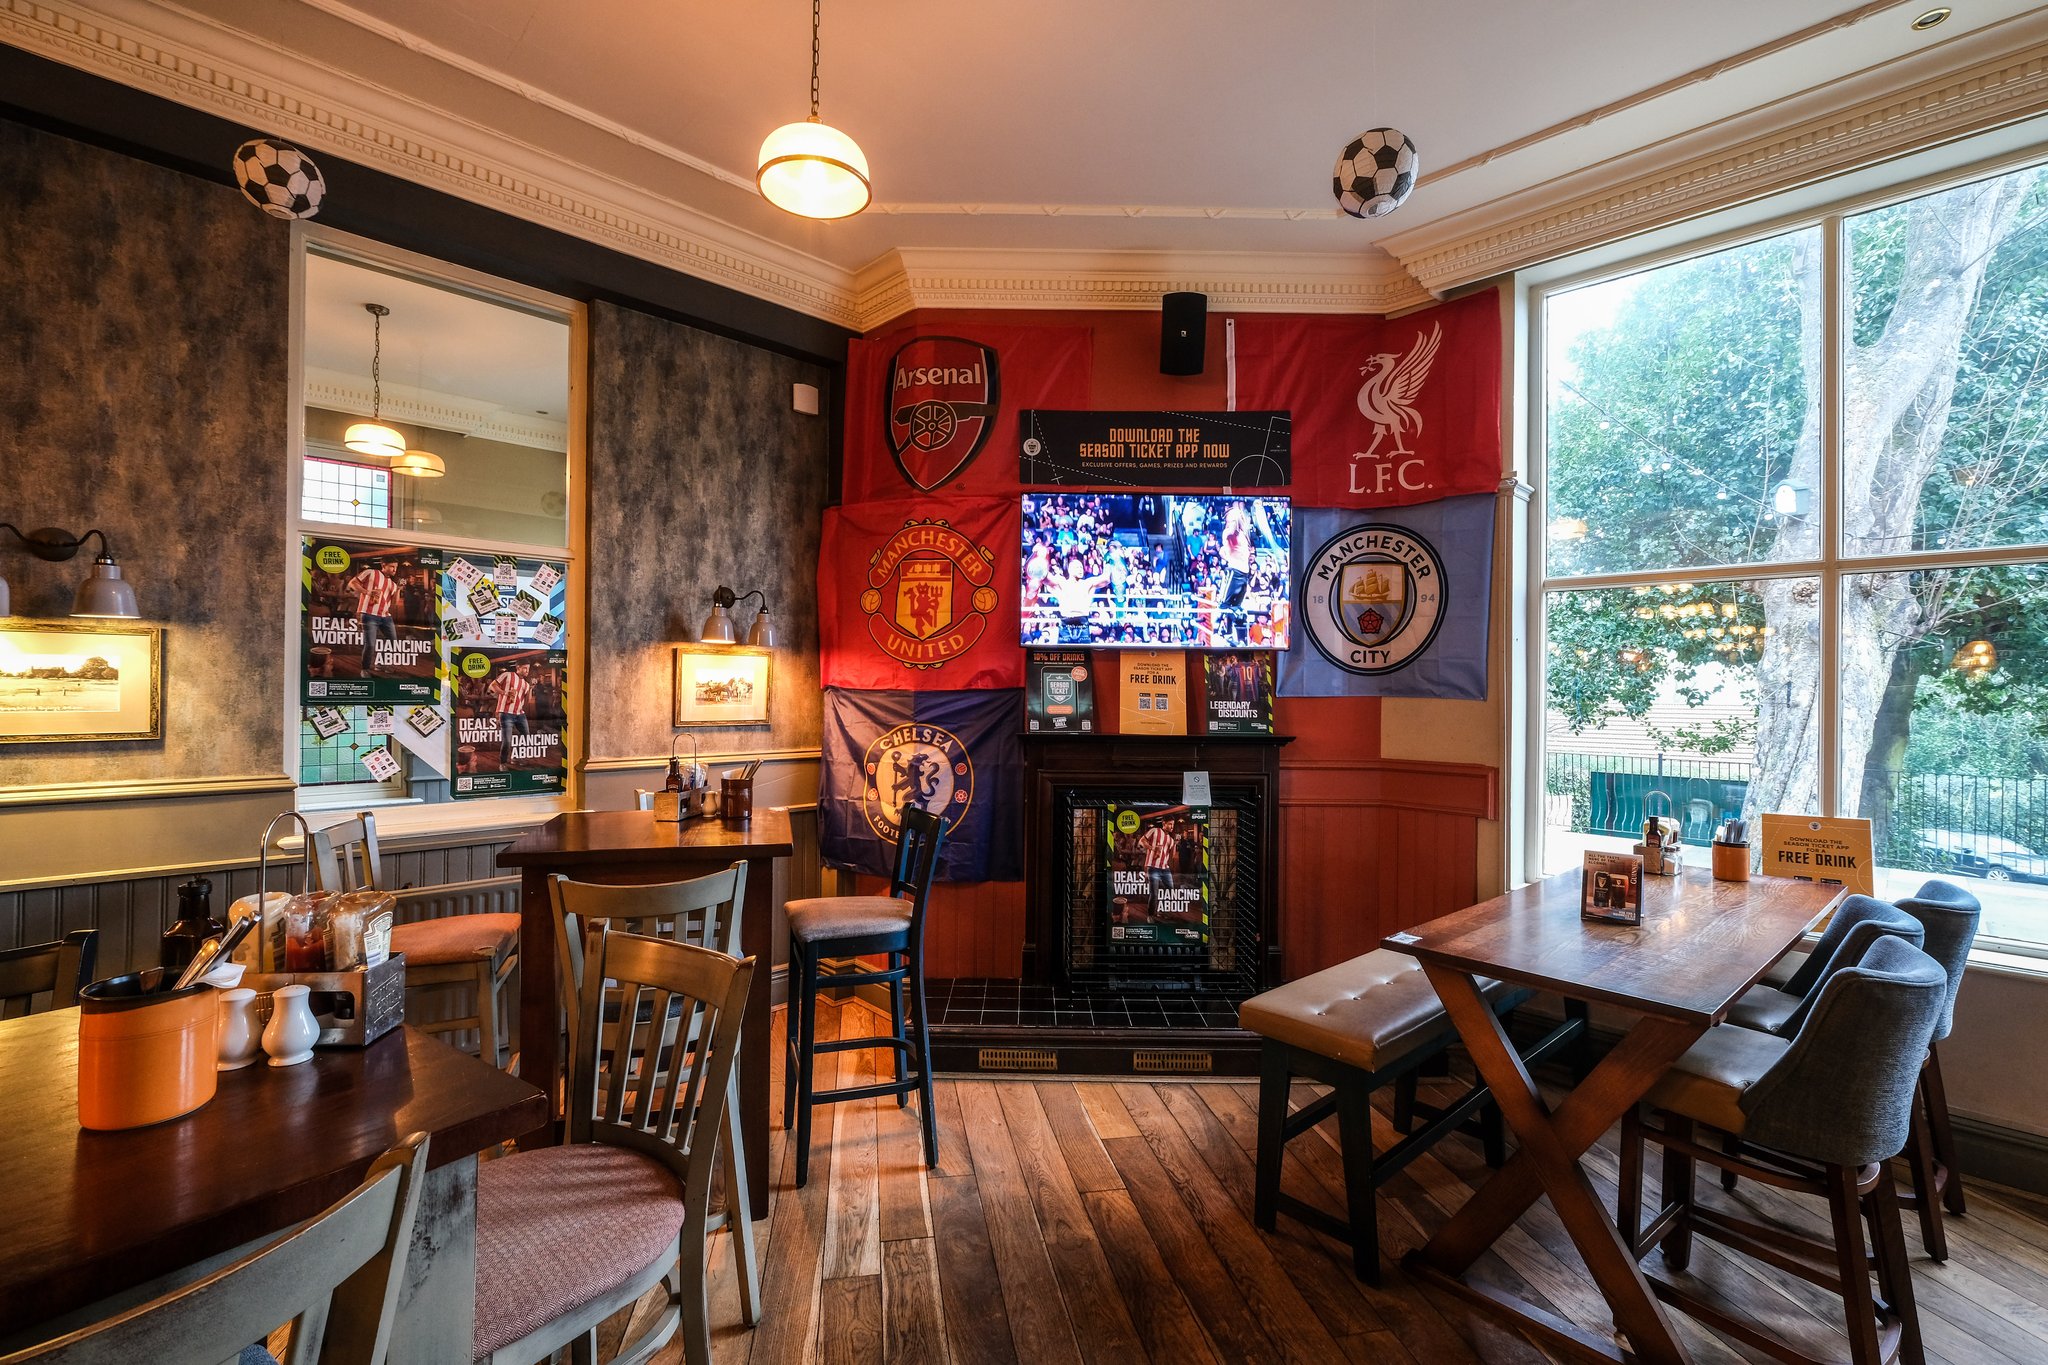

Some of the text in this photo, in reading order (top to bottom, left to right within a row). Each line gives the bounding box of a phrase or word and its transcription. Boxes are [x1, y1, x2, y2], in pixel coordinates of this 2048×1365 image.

[895, 362, 982, 391] Arsenal
[1109, 428, 1200, 443] DOWNLOAD THE
[1079, 443, 1230, 458] SEASON TICKET APP NOW
[1348, 459, 1434, 494] L.F.C.
[877, 530, 983, 578] MANCHESTER
[1317, 535, 1431, 581] MANCHESTER
[1312, 593, 1435, 604] 18 94
[311, 616, 358, 632] DEALS
[312, 630, 364, 646] WORTH
[375, 639, 431, 653] DANCING
[887, 633, 965, 659] UNITED
[374, 652, 418, 666] ABOUT
[1033, 653, 1085, 662] 10% OFF DRINKS
[1350, 650, 1391, 664] CITY
[1130, 674, 1177, 685] FREE DRINK
[1241, 666, 1253, 681] 10
[1210, 701, 1251, 710] LEGENDARY
[1218, 709, 1258, 718] DISCOUNTS
[459, 718, 497, 731] DEALS
[459, 730, 502, 743] WORTH
[511, 734, 559, 747] DANCING
[880, 727, 954, 754] CHELSEA
[510, 746, 548, 759] ABOUT
[1789, 836, 1828, 844] DOWNLOAD
[1778, 850, 1857, 869] FREE DRINK
[1113, 871, 1146, 883] DEALS
[1113, 883, 1150, 895] WORTH
[1157, 889, 1200, 901] DANCING
[1156, 901, 1190, 912] ABOUT
